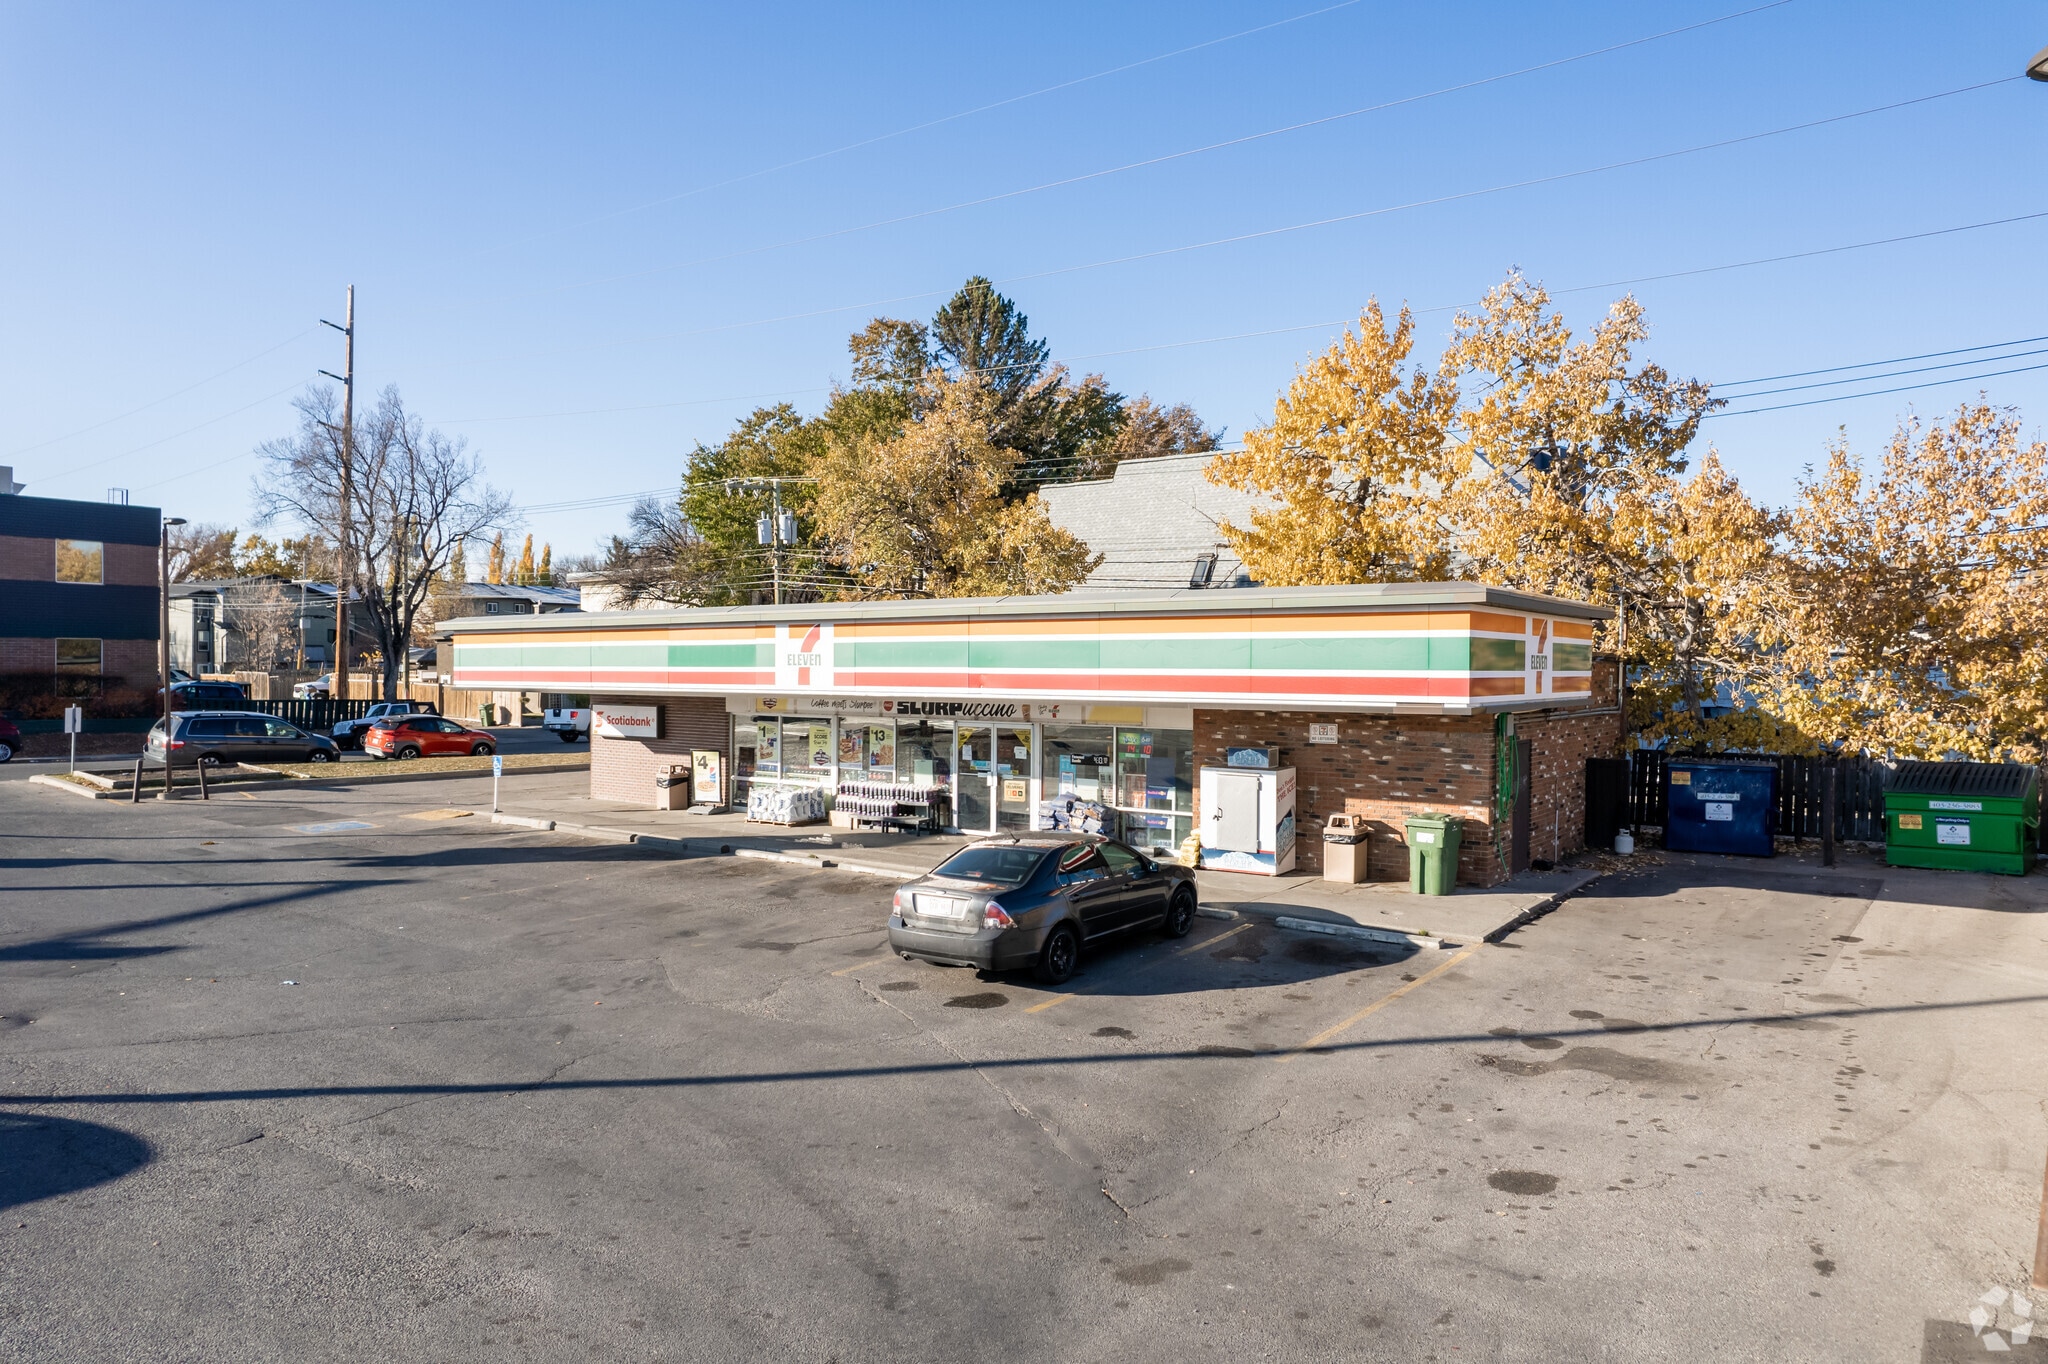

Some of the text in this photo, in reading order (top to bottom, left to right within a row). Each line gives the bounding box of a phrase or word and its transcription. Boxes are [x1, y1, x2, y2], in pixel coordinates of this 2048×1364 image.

[787, 653, 822, 667] ELEVEN
[798, 623, 821, 686] 7
[1530, 654, 1548, 670] ELEVEN
[606, 715, 651, 727] Scotiabank
